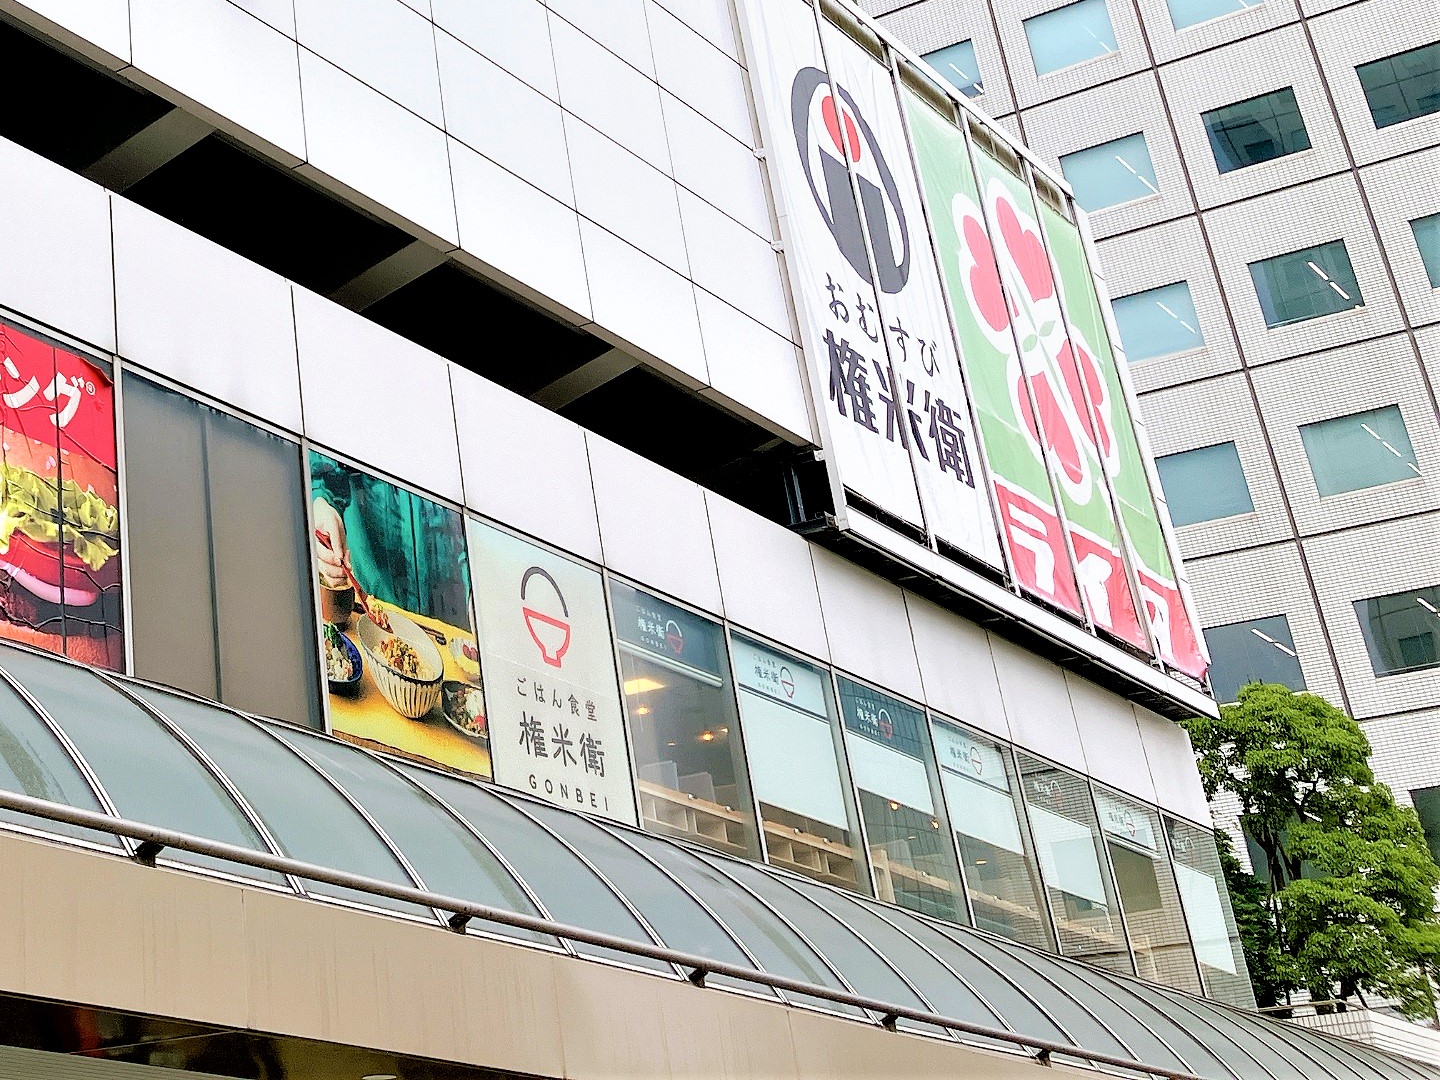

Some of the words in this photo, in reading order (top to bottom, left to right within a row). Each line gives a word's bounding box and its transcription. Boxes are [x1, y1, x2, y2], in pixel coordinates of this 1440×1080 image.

[825, 272, 940, 377] おむすび
[822, 328, 976, 489] 権米衛
[517, 677, 598, 721] ごはん食堂
[519, 711, 605, 777] 権米衛
[528, 774, 609, 811] GONBEI
